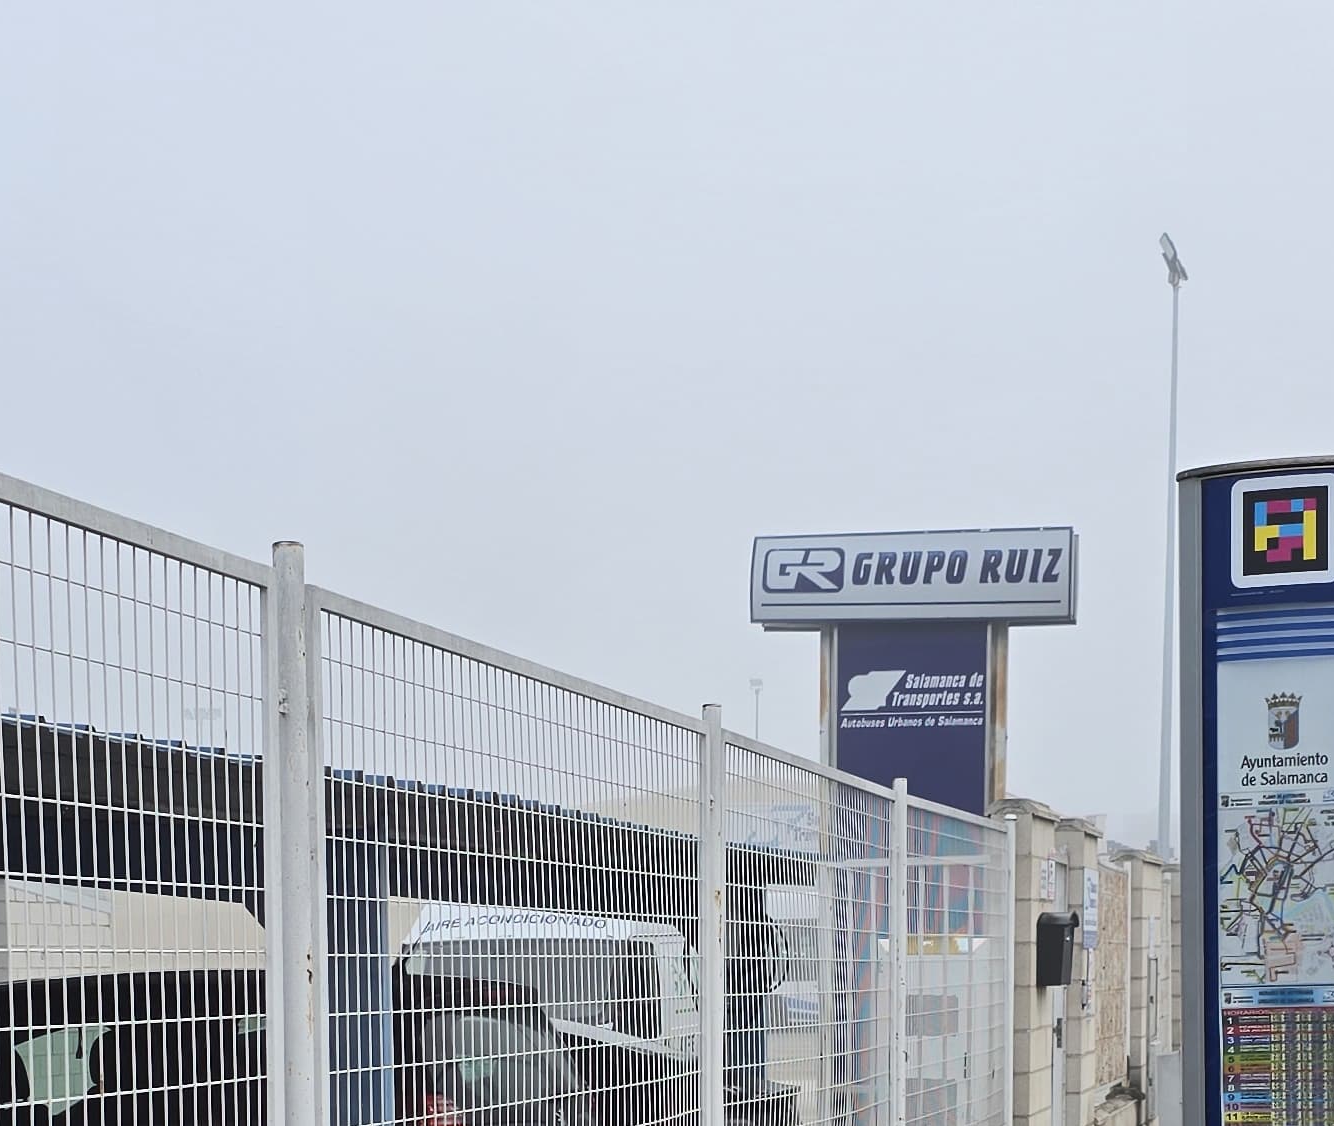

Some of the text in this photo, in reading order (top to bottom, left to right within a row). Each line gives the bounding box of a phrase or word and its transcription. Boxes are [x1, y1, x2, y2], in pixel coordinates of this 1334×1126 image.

[852, 548, 1063, 586] GRUPO RUIZ
[905, 672, 984, 689] Salamanca de
[892, 690, 984, 708] Transportes s.a.
[841, 715, 983, 729] Autobuses Urbanos de Salamanca
[1240, 752, 1329, 772] Ayuntamiento
[1241, 770, 1328, 787] de Salamanca
[425, 919, 461, 934] AIRE
